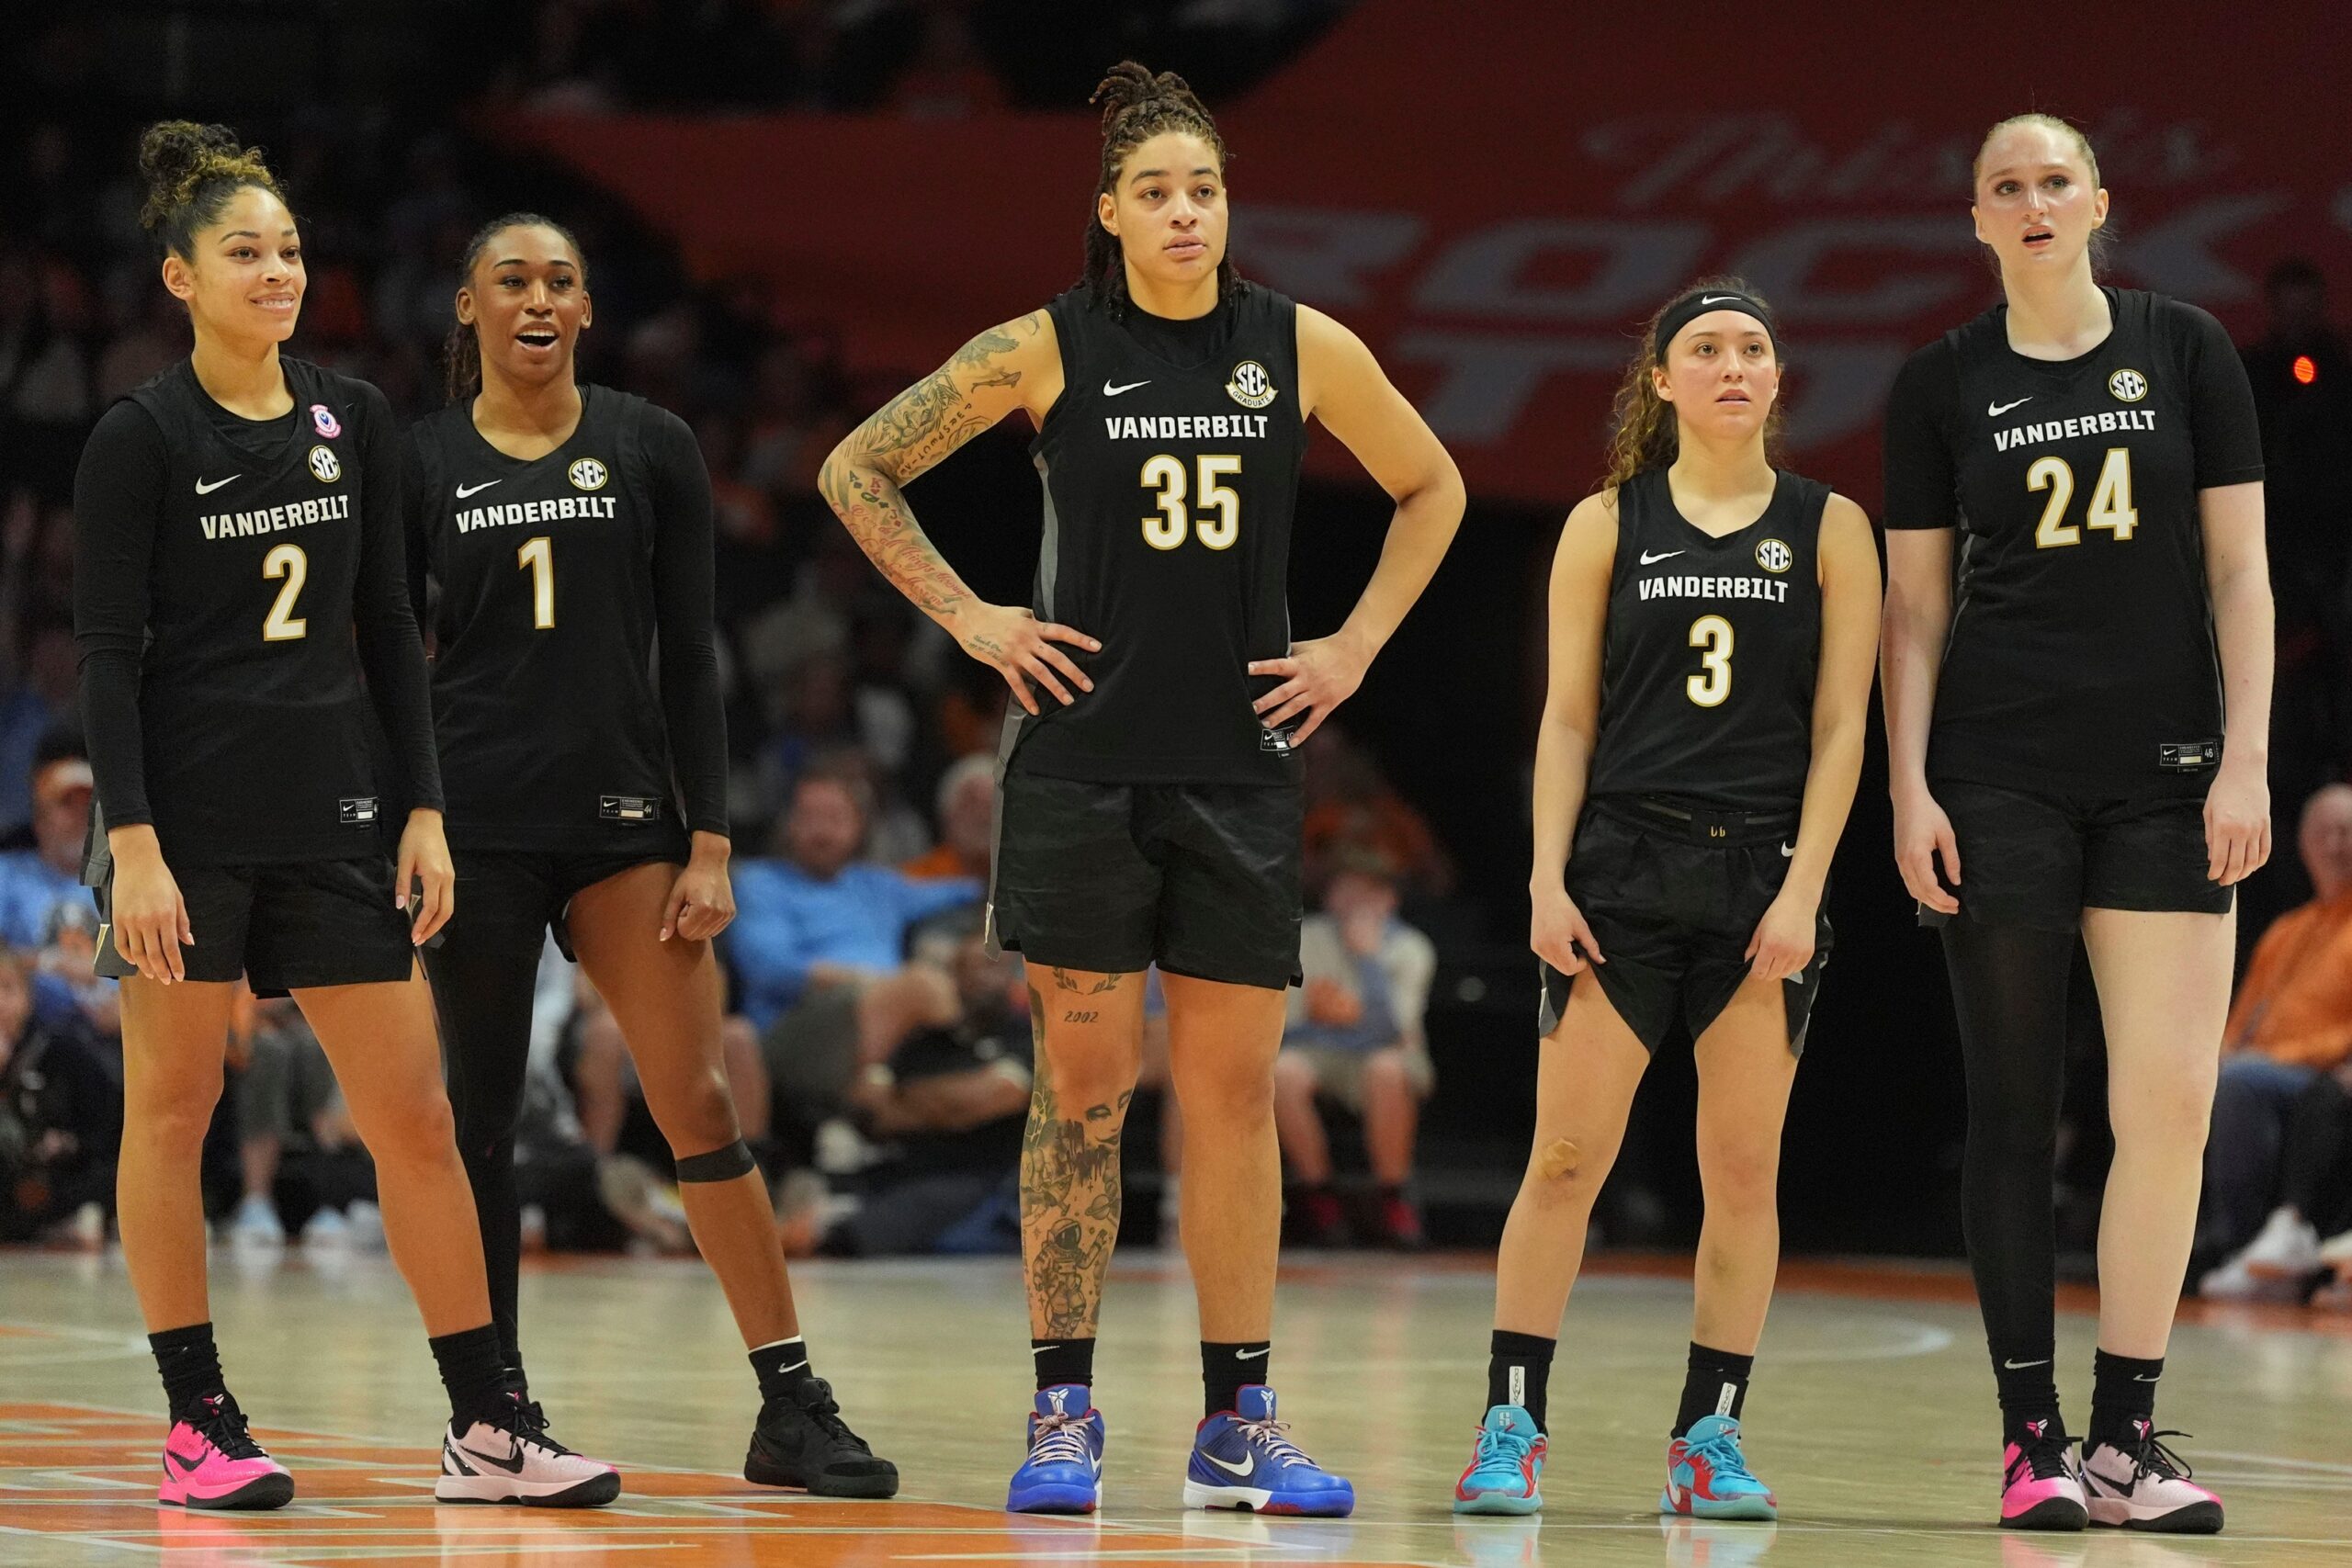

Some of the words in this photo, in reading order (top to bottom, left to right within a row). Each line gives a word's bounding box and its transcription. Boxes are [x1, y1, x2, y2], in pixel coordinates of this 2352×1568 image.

[1235, 363, 1266, 396] SEC
[2111, 371, 2145, 400] SEC
[1232, 390, 1271, 407] GRADUATE
[1105, 415, 1268, 440] VANDERBILT
[1994, 410, 2155, 452] VANDERBILT
[311, 446, 340, 480] SEC
[571, 460, 605, 489] SEC
[1140, 454, 1242, 550] 35
[2027, 447, 2138, 548] 24
[200, 494, 349, 540] VANDERBILT
[456, 496, 616, 534] VANDERBILT
[1758, 541, 1791, 570] SEC
[263, 544, 307, 641] 2
[518, 536, 555, 629] 1
[1638, 576, 1789, 604] VANDERBILT
[1687, 615, 1735, 707] 3
[1064, 1010, 1099, 1023] 2002
